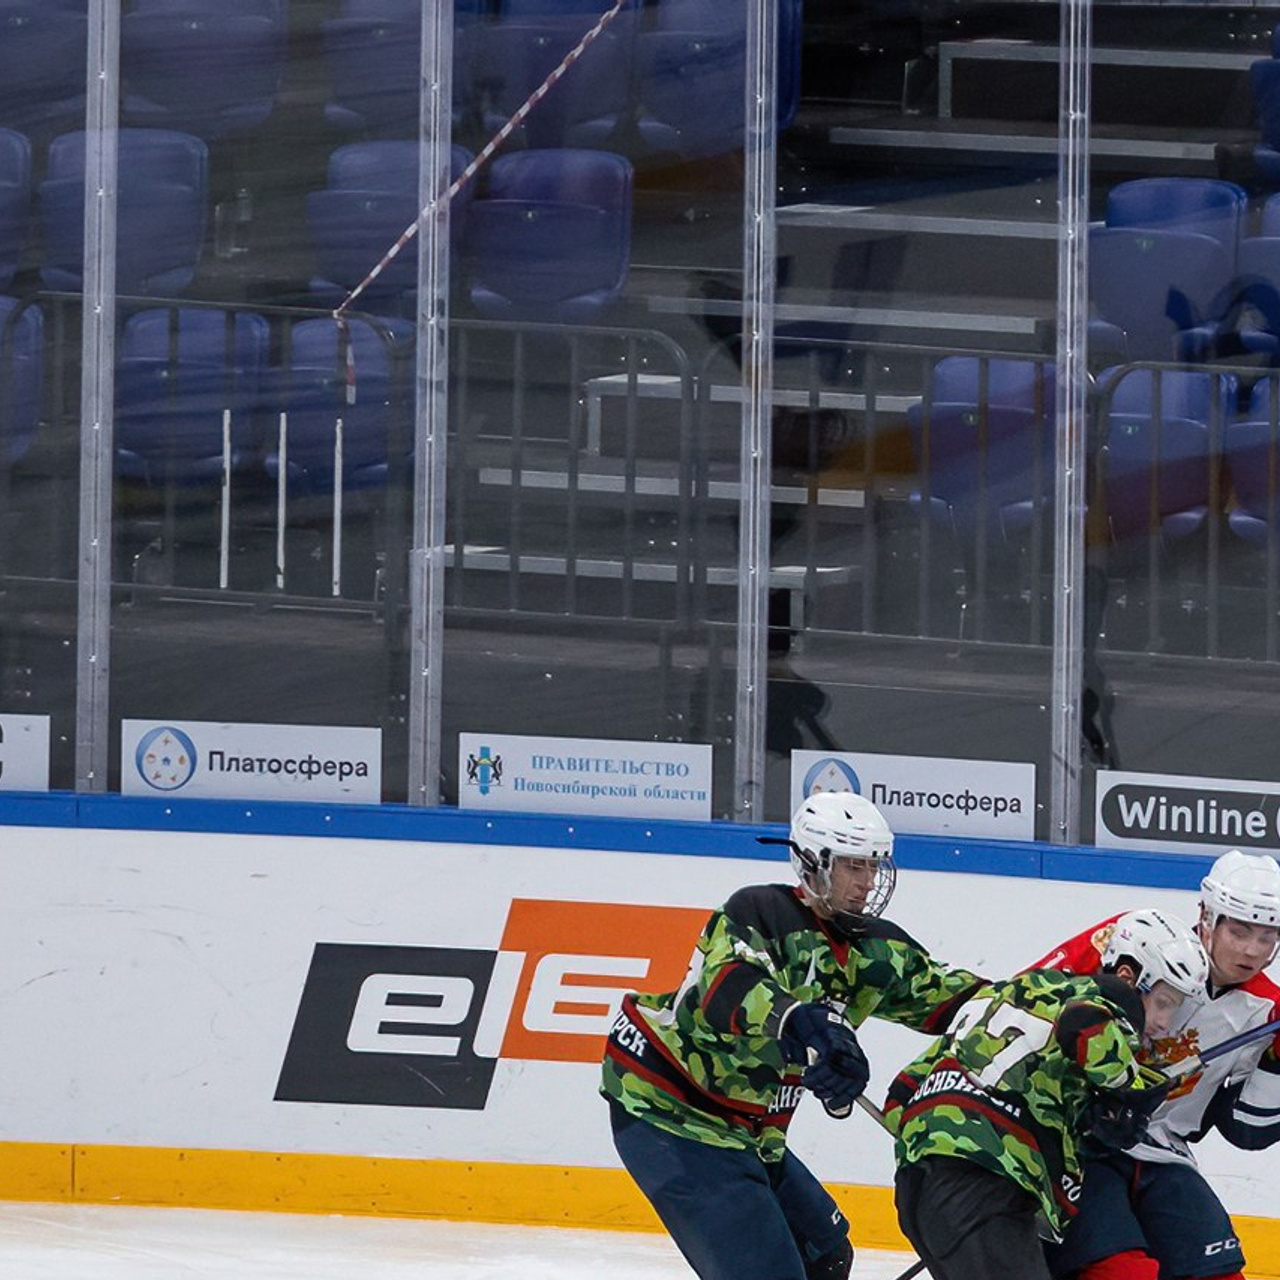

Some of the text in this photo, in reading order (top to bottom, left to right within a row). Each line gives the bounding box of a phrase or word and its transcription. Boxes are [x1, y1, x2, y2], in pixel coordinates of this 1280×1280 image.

[208, 750, 369, 782] Платосфера
[531, 754, 690, 778] ПРАВИТЕЛЬСТВО
[513, 777, 707, 801] Новосибирской области
[871, 783, 1023, 817] Платосфера
[1117, 793, 1267, 839] Winline
